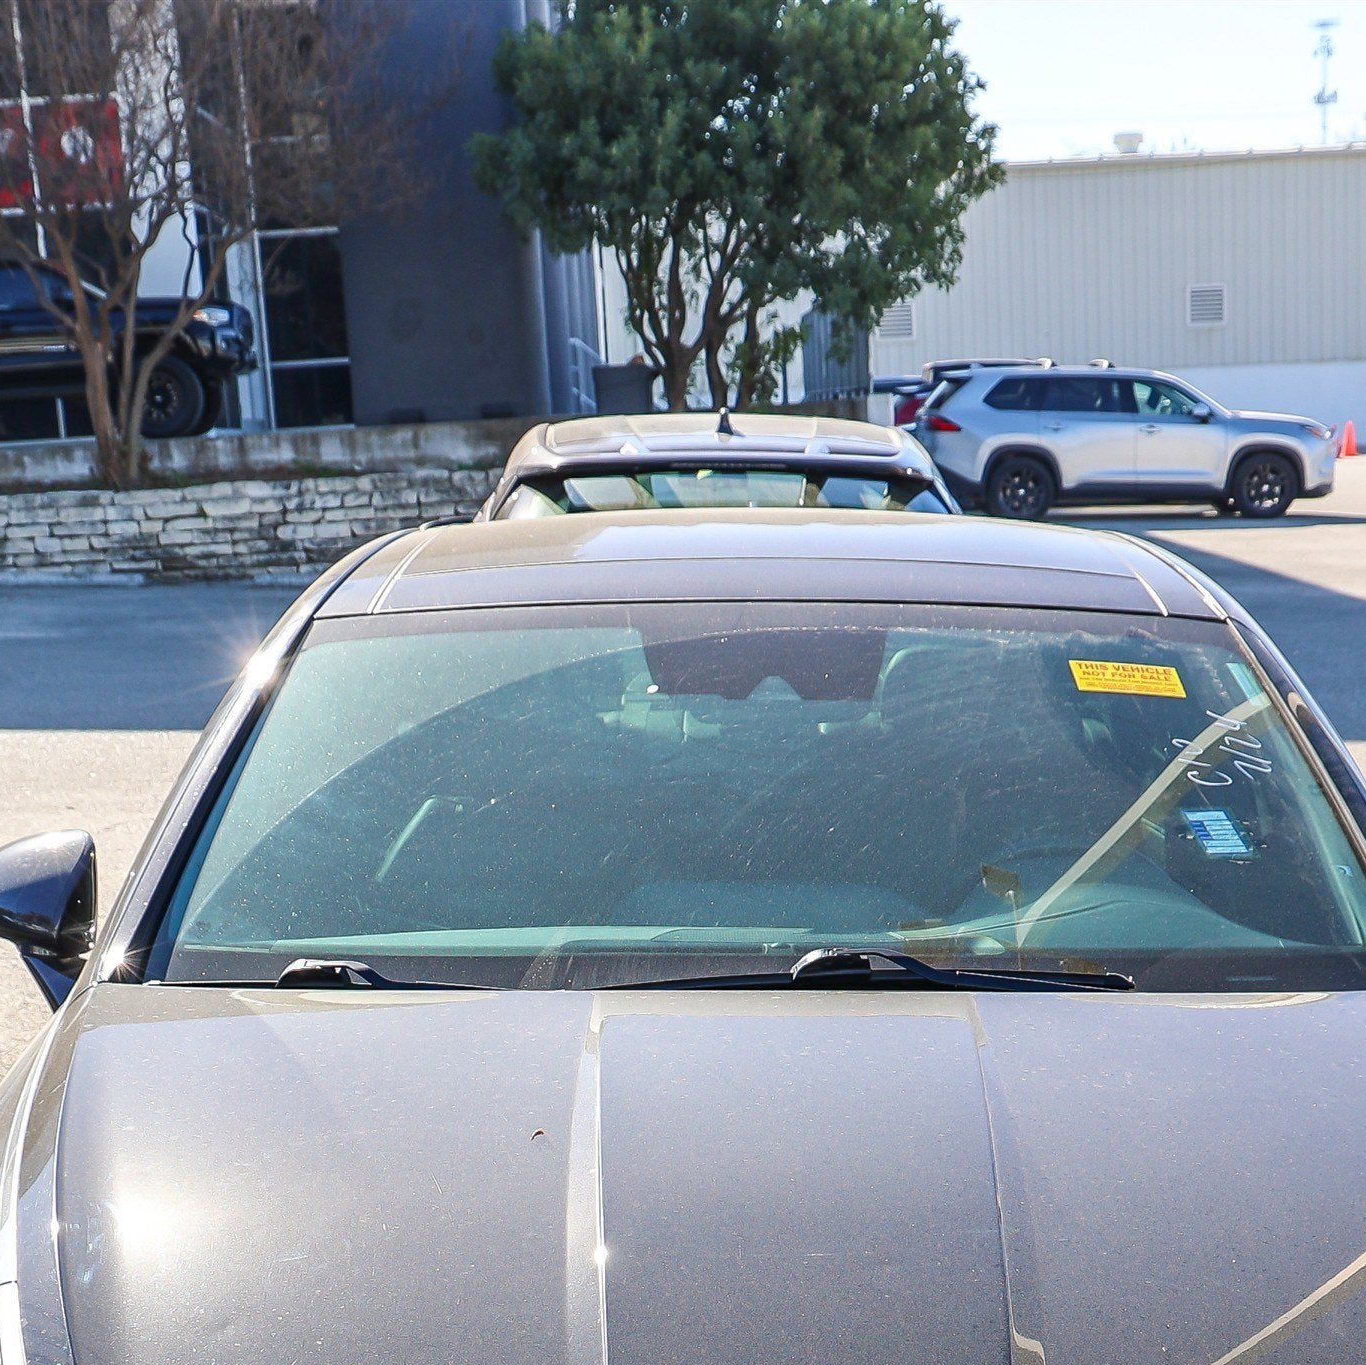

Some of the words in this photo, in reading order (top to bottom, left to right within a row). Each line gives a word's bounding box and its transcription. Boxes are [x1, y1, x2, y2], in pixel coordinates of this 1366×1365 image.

[1075, 661, 1109, 672] THIS
[1111, 663, 1173, 677] VEHICLE
[1081, 670, 1107, 679] NOT
[1110, 671, 1137, 680] FOR
[1140, 673, 1173, 683] SALE
